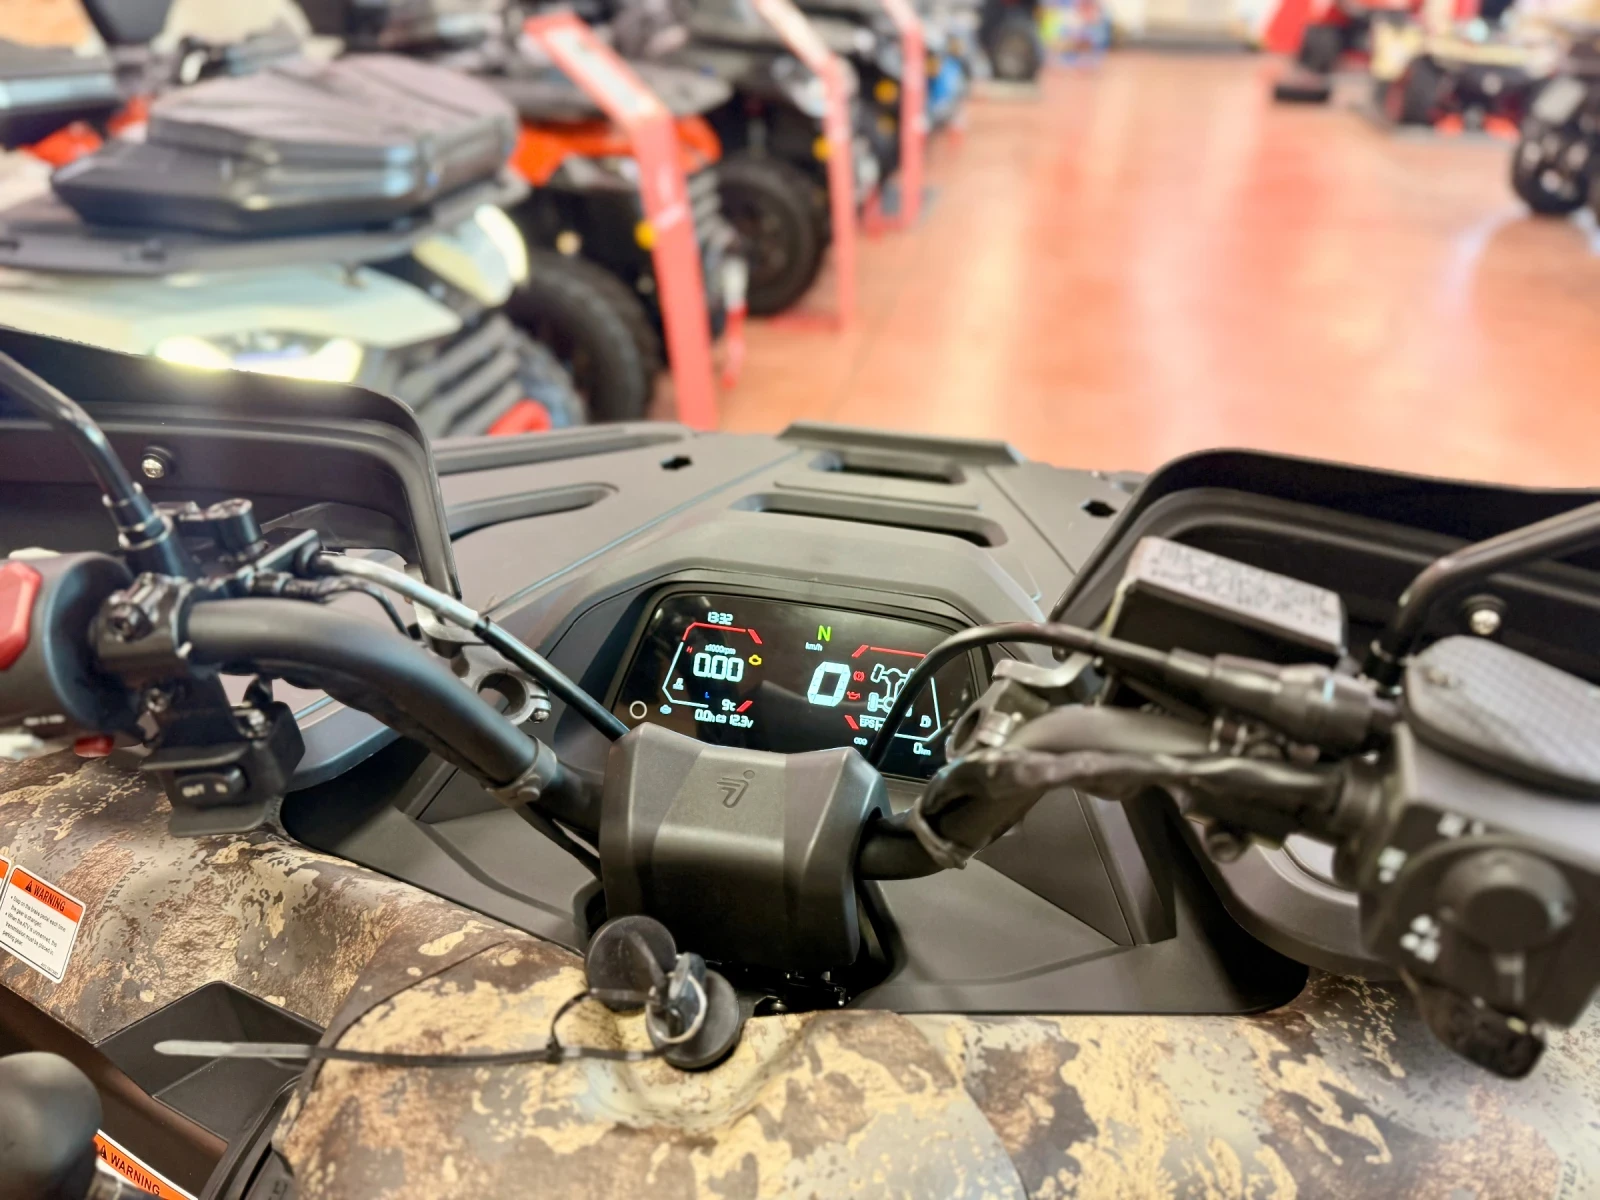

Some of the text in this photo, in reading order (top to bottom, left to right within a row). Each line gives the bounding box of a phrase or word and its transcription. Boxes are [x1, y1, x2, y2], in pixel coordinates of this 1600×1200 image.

[817, 624, 832, 642] N
[686, 646, 693, 654] H
[805, 642, 823, 651] km/h
[692, 652, 745, 683] 0.00
[807, 661, 851, 707] 0
[705, 691, 710, 699] L
[860, 717, 875, 729] EPS
[33, 884, 66, 913] WARNING
[110, 1151, 161, 1196] WARNING
